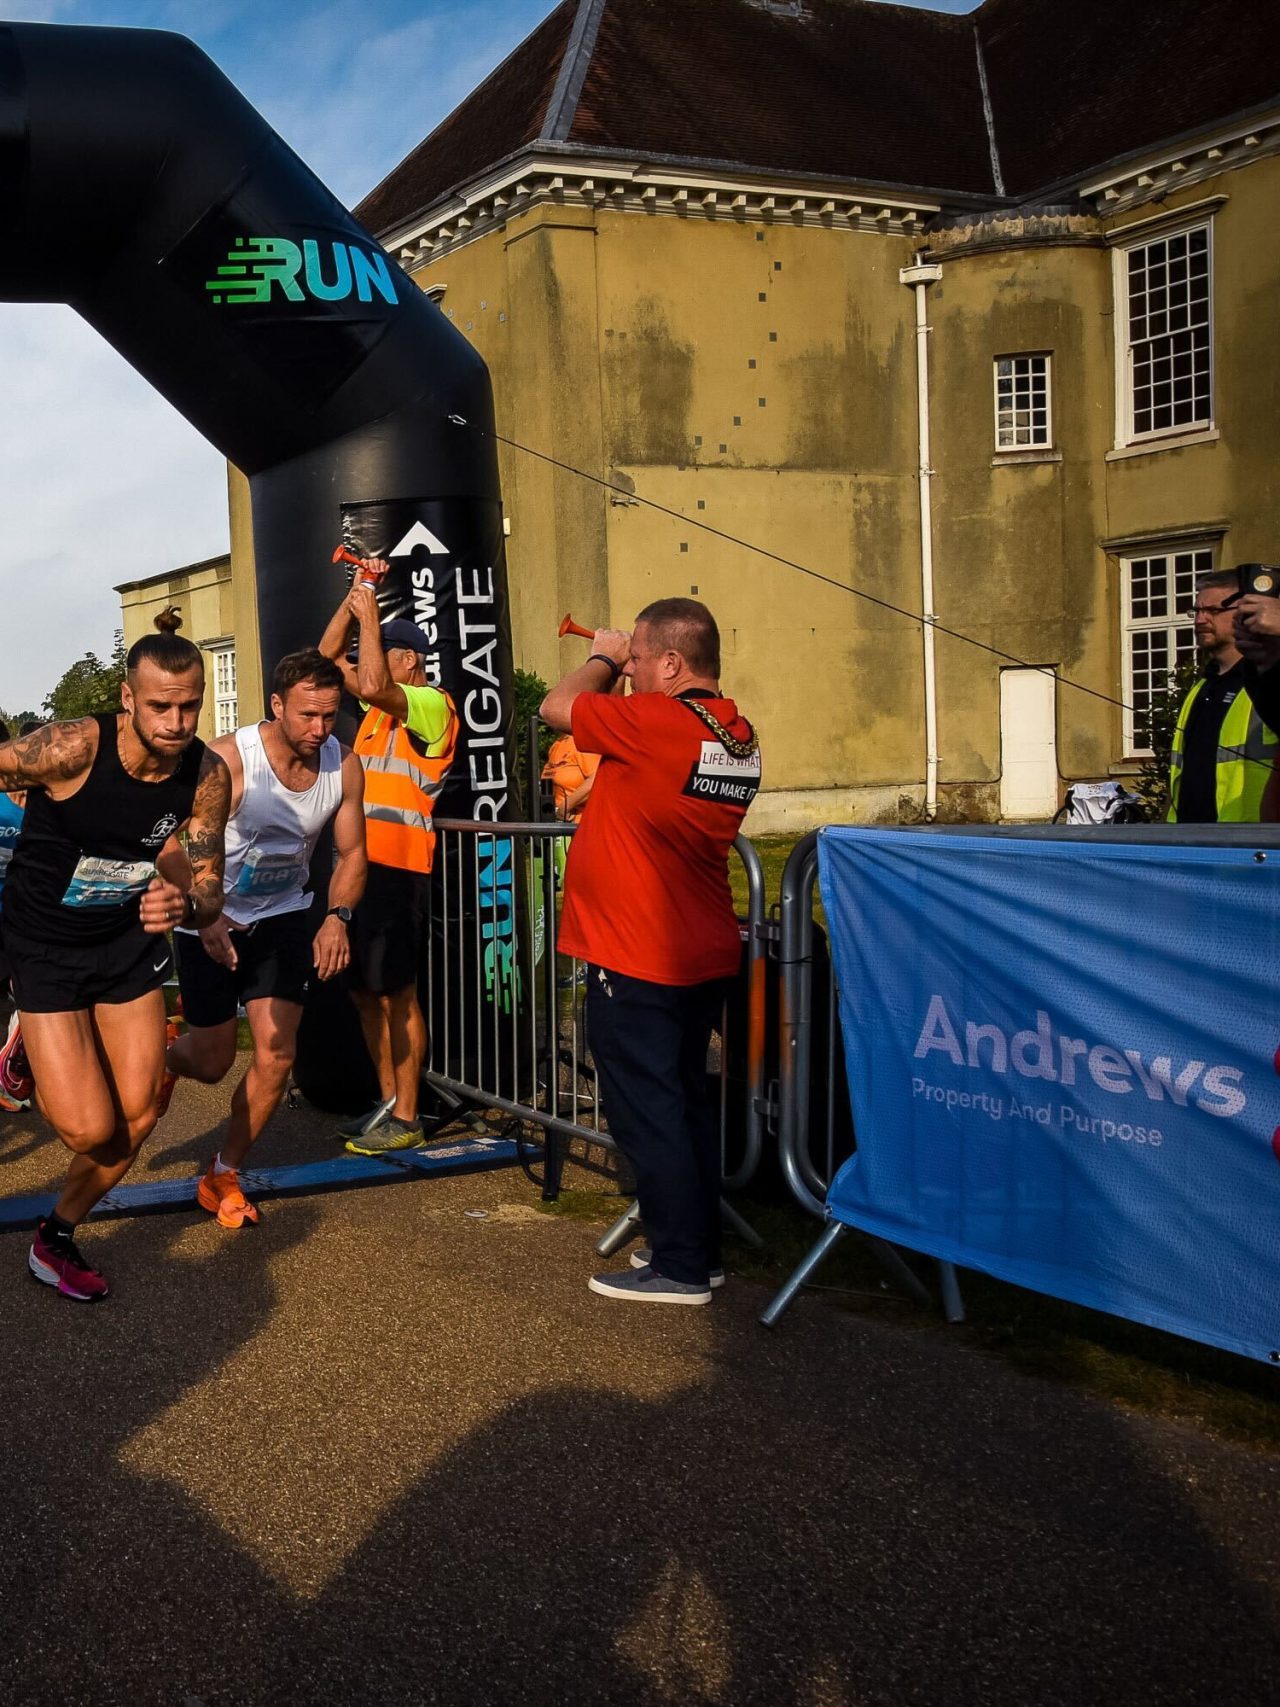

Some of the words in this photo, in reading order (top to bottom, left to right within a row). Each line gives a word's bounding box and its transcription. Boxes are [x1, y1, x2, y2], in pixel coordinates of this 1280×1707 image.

[206, 237, 398, 304] RUN
[692, 777, 719, 794] YOU
[720, 782, 746, 799] MAKE
[746, 788, 757, 800] IT
[702, 752, 725, 766] LIFE
[726, 754, 735, 766] IS
[737, 756, 760, 768] WHAT
[913, 994, 1247, 1117] Andrews
[912, 1078, 1002, 1120] Property
[1009, 1096, 1052, 1126] And
[1061, 1106, 1163, 1148] Purpose
